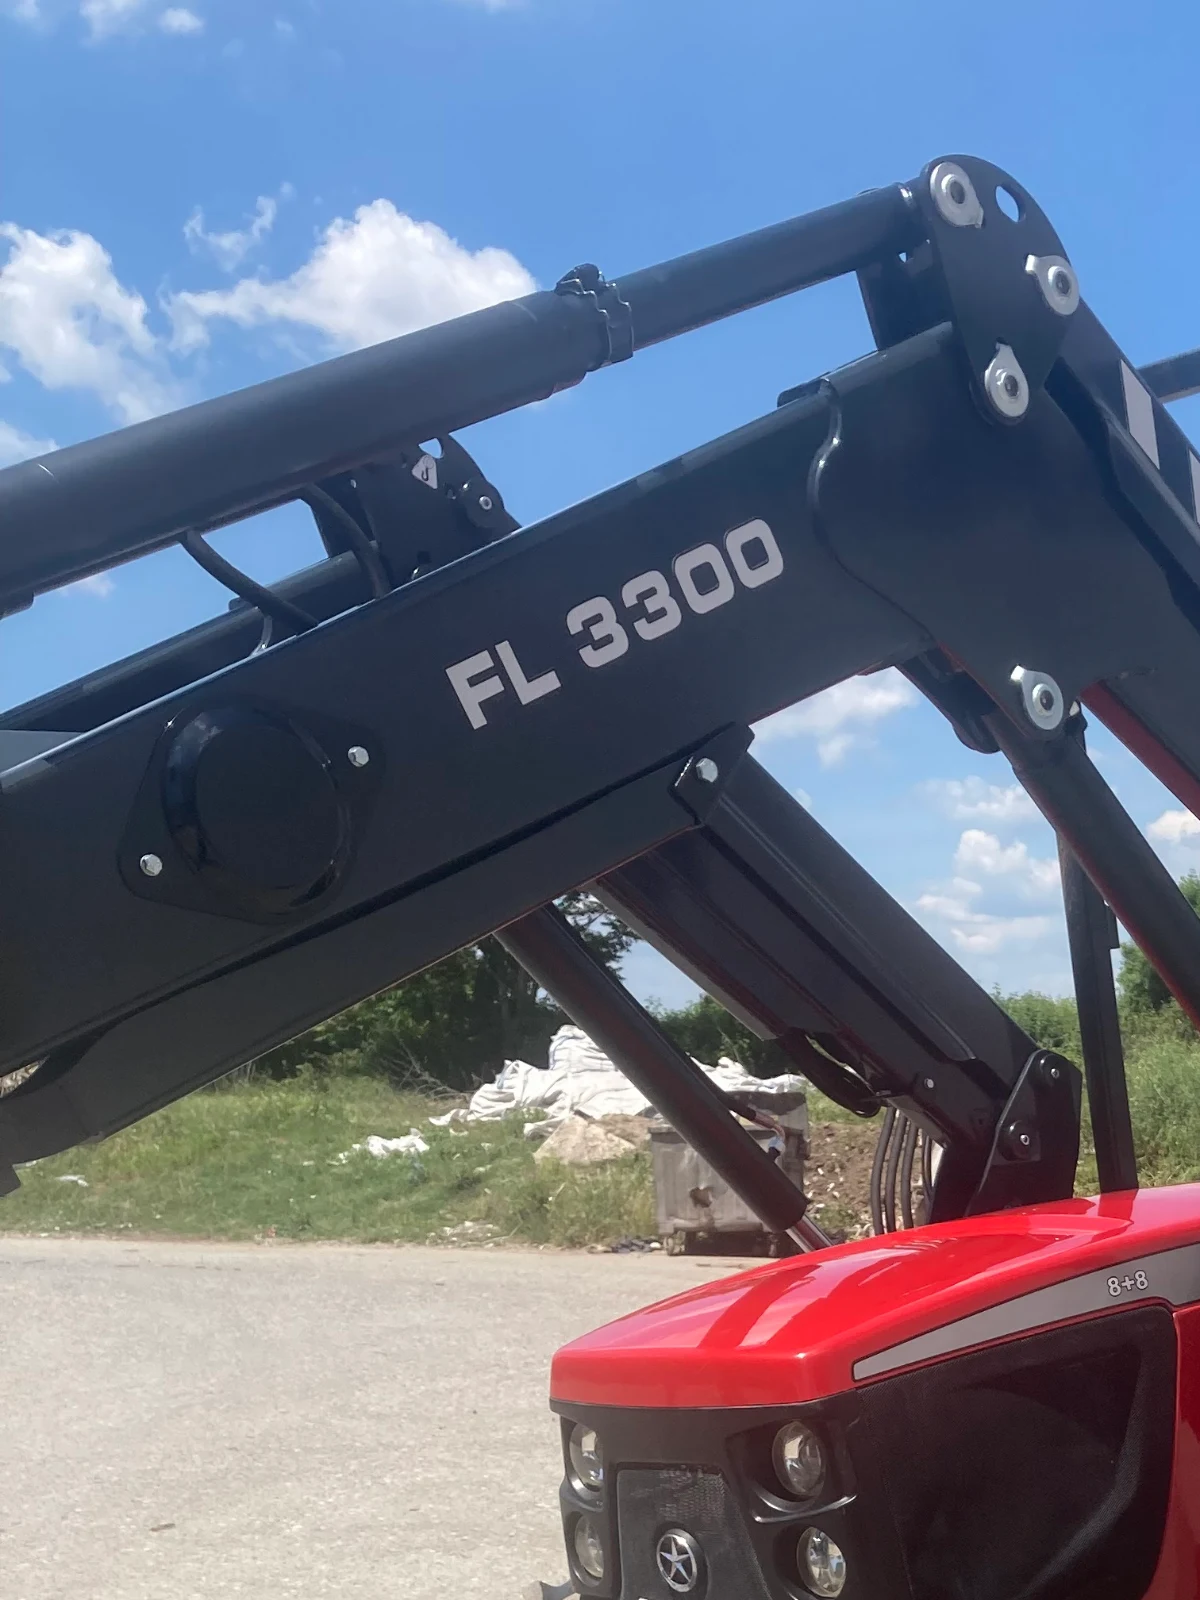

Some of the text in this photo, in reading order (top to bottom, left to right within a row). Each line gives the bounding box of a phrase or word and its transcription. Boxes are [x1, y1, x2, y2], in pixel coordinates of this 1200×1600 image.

[445, 517, 784, 730] FL 3300
[1106, 1269, 1149, 1298] 8+8
